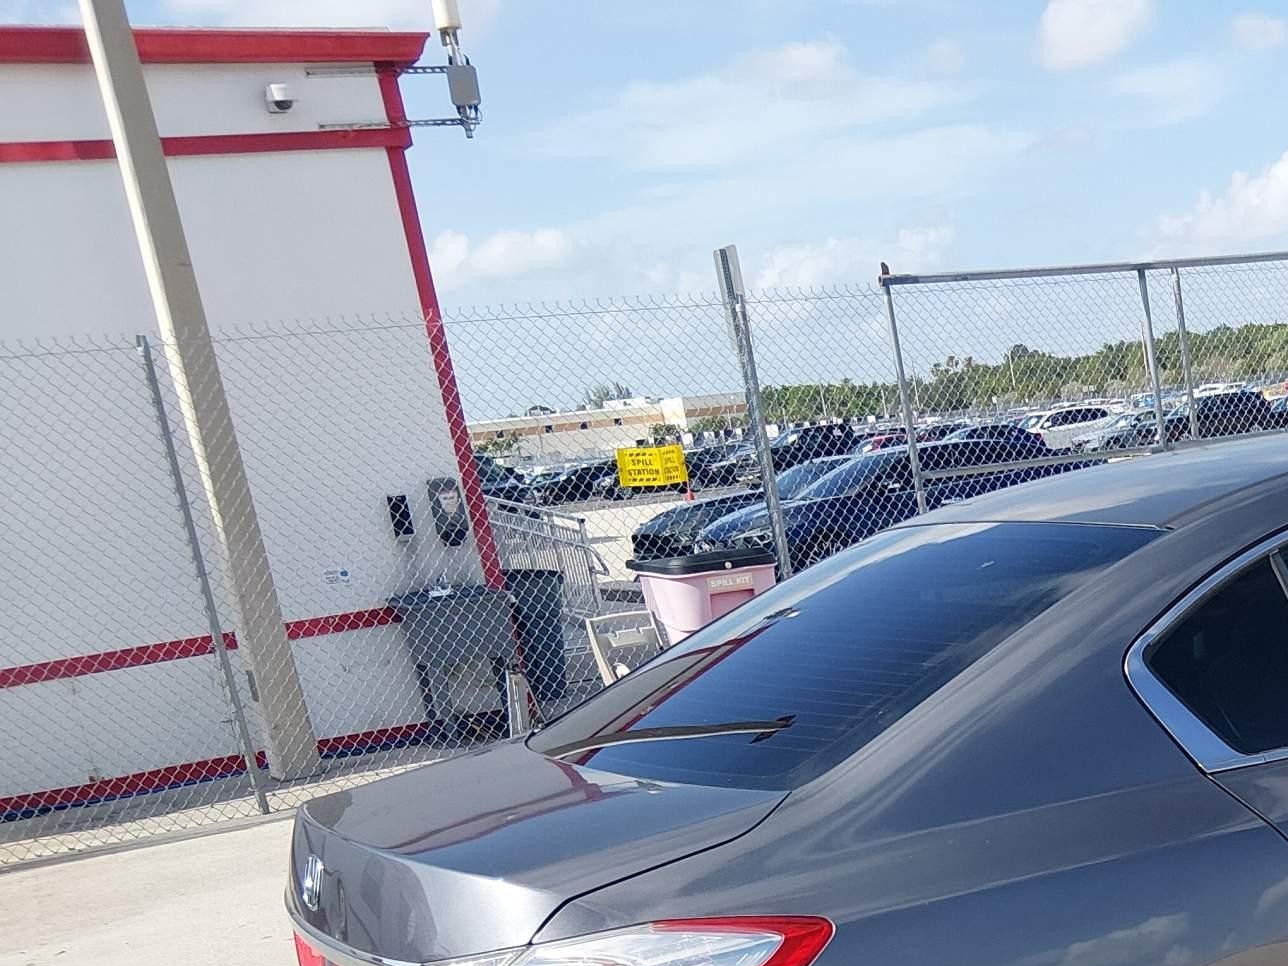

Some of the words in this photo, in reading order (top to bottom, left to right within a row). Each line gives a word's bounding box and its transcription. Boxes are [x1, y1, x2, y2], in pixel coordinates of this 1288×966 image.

[627, 468, 660, 476] STATION
[710, 577, 734, 588] SPILL
[736, 575, 750, 585] KIT
